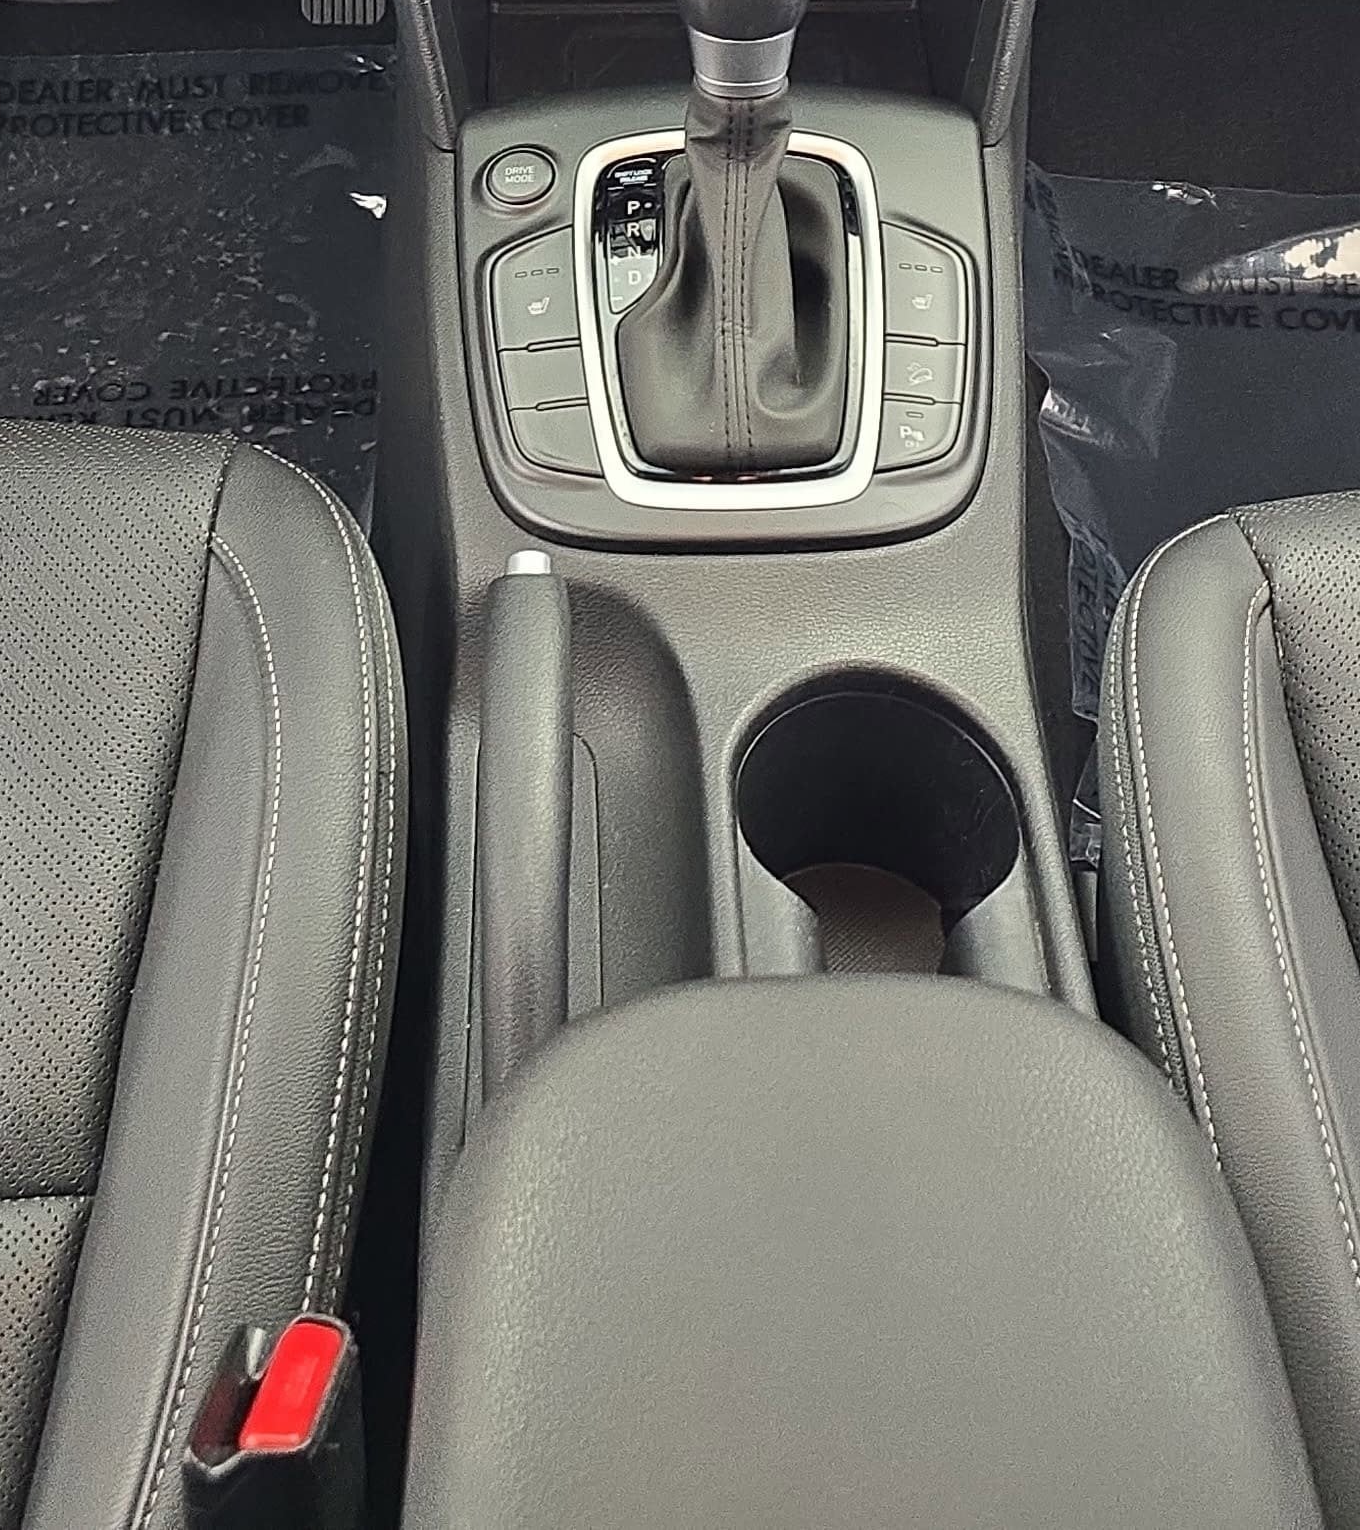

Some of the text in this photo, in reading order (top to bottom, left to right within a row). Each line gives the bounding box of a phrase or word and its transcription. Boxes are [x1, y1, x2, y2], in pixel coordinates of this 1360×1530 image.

[136, 72, 227, 102] MUST
[249, 69, 388, 96] REMOVE
[201, 104, 312, 132] COVER
[505, 166, 535, 175] DRIVE
[505, 174, 535, 183] MODE
[627, 201, 640, 214] P
[627, 223, 640, 236] R
[628, 271, 640, 284] D
[32, 381, 153, 408] COVER
[900, 426, 912, 438] P
